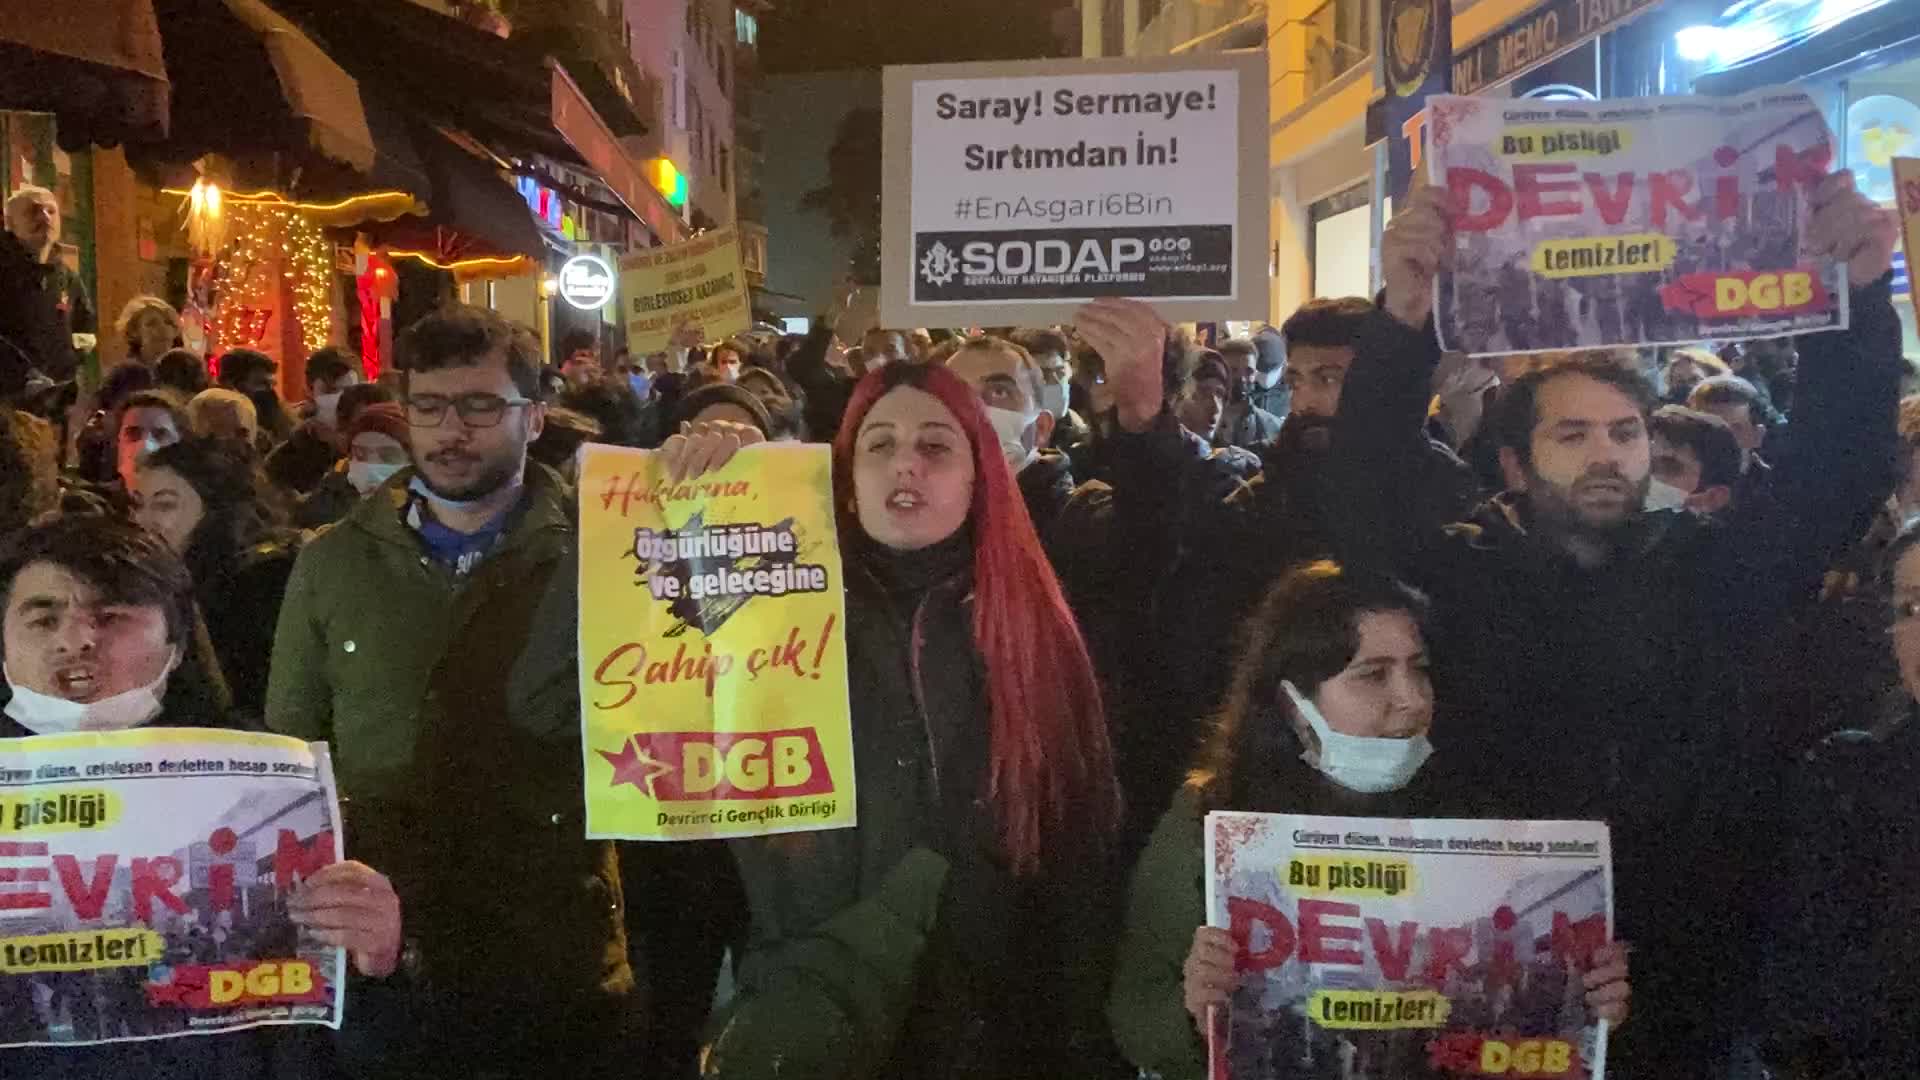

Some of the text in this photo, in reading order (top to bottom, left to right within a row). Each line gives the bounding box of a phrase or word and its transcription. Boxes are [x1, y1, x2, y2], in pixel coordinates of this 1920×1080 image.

[936, 84, 1216, 124] Saray! Sermaye!
[965, 131, 1177, 171] Sırtımdan İn!
[1502, 136, 1532, 155] Bu
[954, 193, 1173, 222] #EnAsgari6Bin
[961, 238, 1145, 275] SODAP
[1715, 273, 1813, 311] DGB
[650, 564, 825, 599] ve geleceğine
[594, 613, 836, 710] Sahip çık!
[682, 736, 813, 793] DGB
[14, 792, 106, 830] pisliği
[657, 799, 836, 826] Devrimci Gençlik Birliği
[1289, 860, 1407, 896] Bu pisliği
[209, 962, 313, 1005] DGB
[1480, 1039, 1573, 1074] DGB
